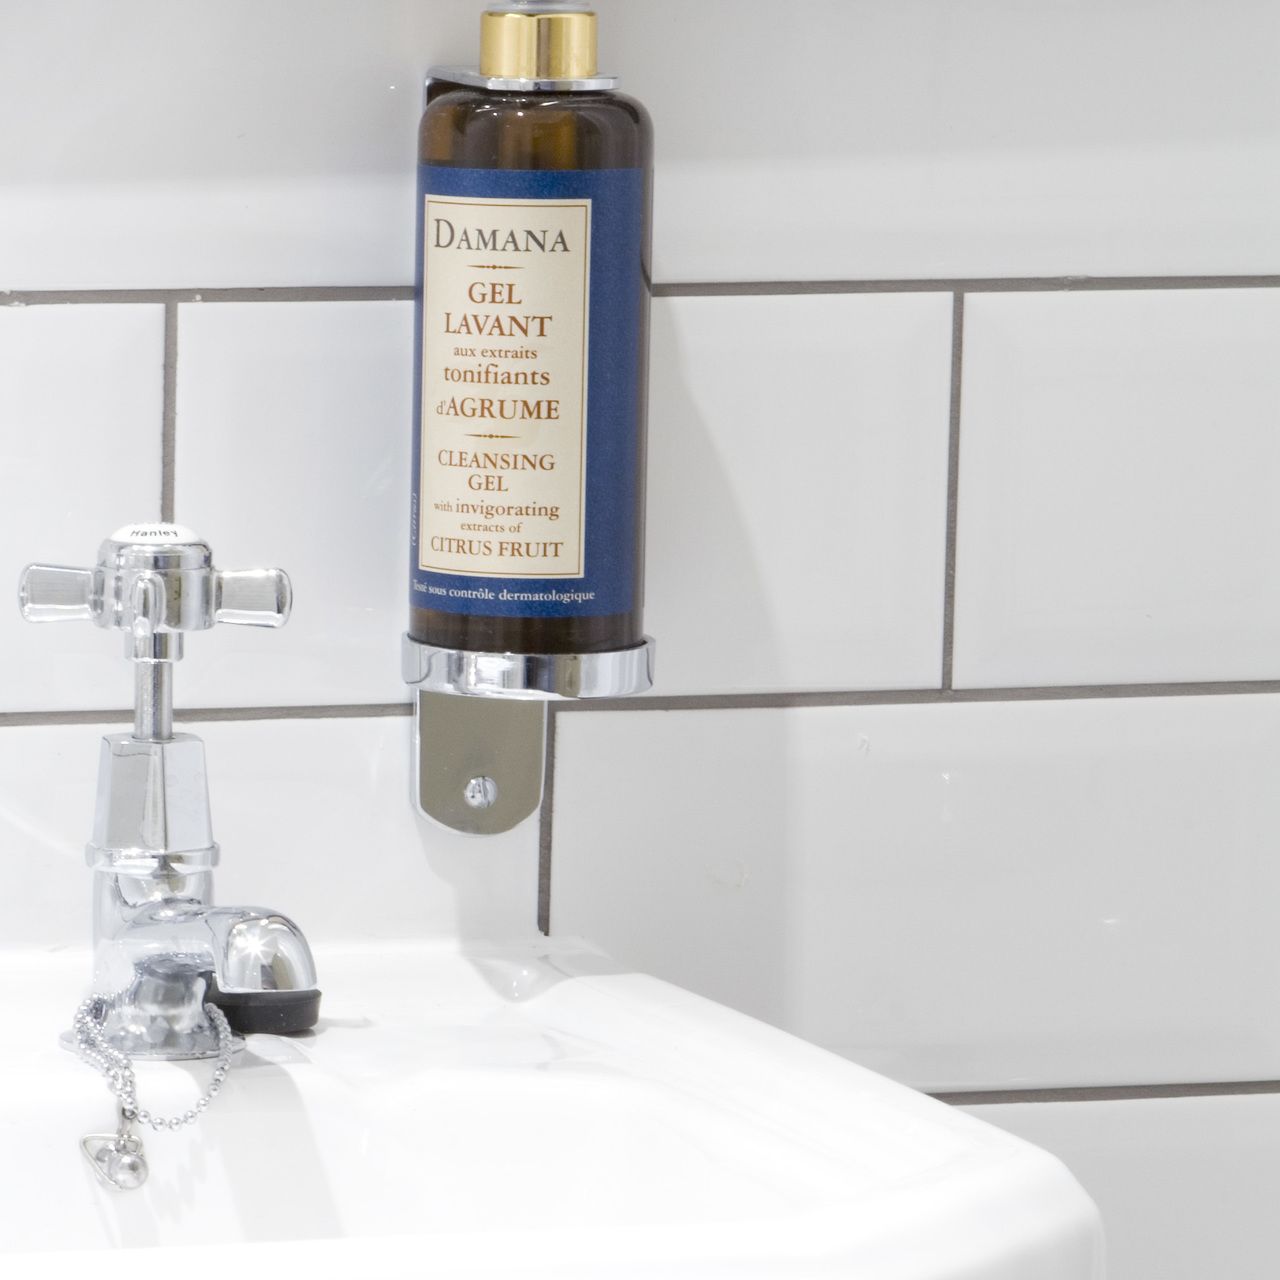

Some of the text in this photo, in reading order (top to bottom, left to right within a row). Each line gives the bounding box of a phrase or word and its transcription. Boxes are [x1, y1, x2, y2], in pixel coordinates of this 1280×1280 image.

[434, 218, 570, 252] DAMANA
[468, 282, 522, 304] GEL
[444, 312, 553, 337] LAVANT
[453, 346, 538, 359] aux extraits
[444, 363, 550, 385] tonifiants
[436, 396, 560, 420] d'AGRUME
[438, 449, 555, 470] CLEANSING
[468, 474, 508, 492] GEL
[434, 498, 560, 520] with invigorating
[460, 522, 523, 533] extracts of
[431, 536, 564, 558] CITRUS FRUIT
[428, 585, 446, 596] sous
[449, 587, 495, 600] contrôle
[498, 589, 595, 603] dermatologique
